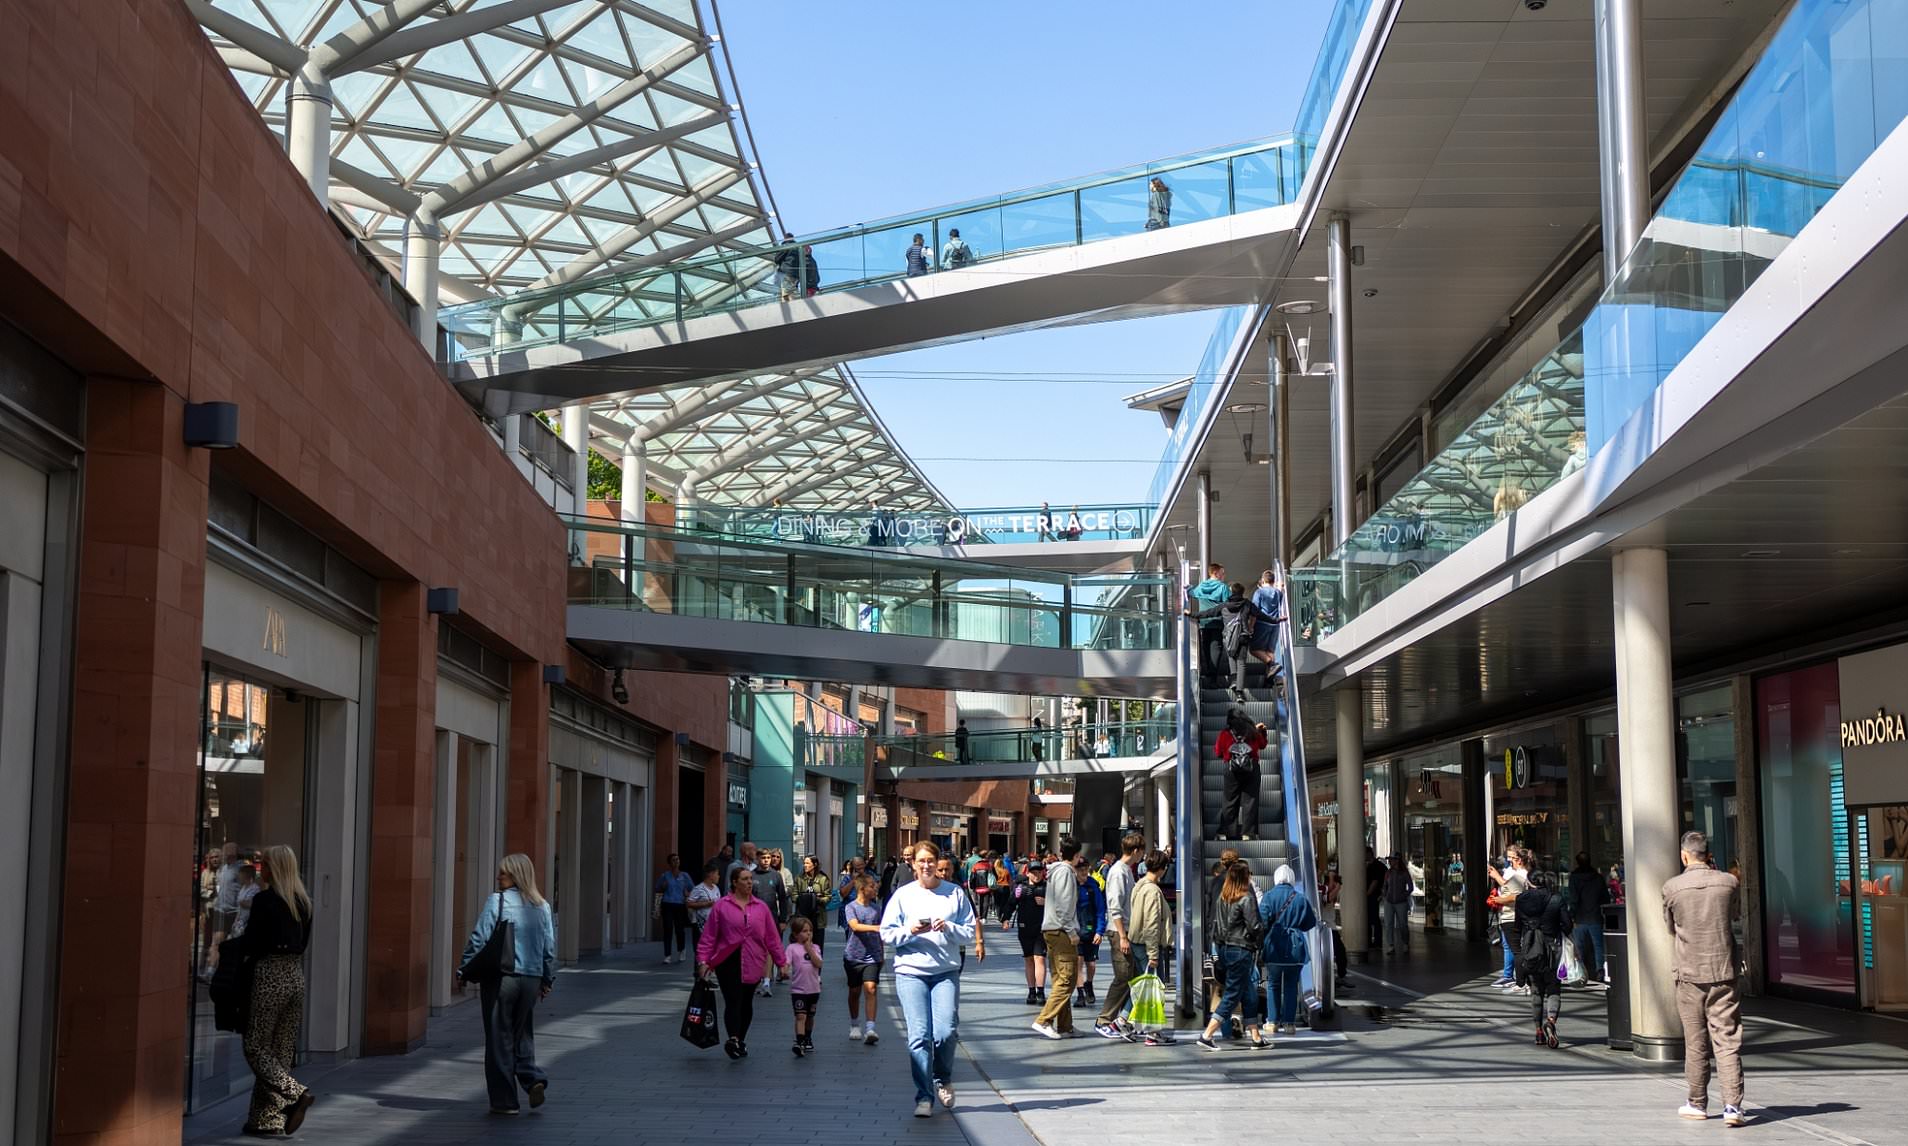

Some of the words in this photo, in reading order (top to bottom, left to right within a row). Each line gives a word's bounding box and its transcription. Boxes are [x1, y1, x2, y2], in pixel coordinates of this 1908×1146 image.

[878, 519, 944, 537] MORE
[948, 518, 981, 536] ON
[984, 516, 1004, 526] THE
[1008, 513, 1110, 533] TERRACE
